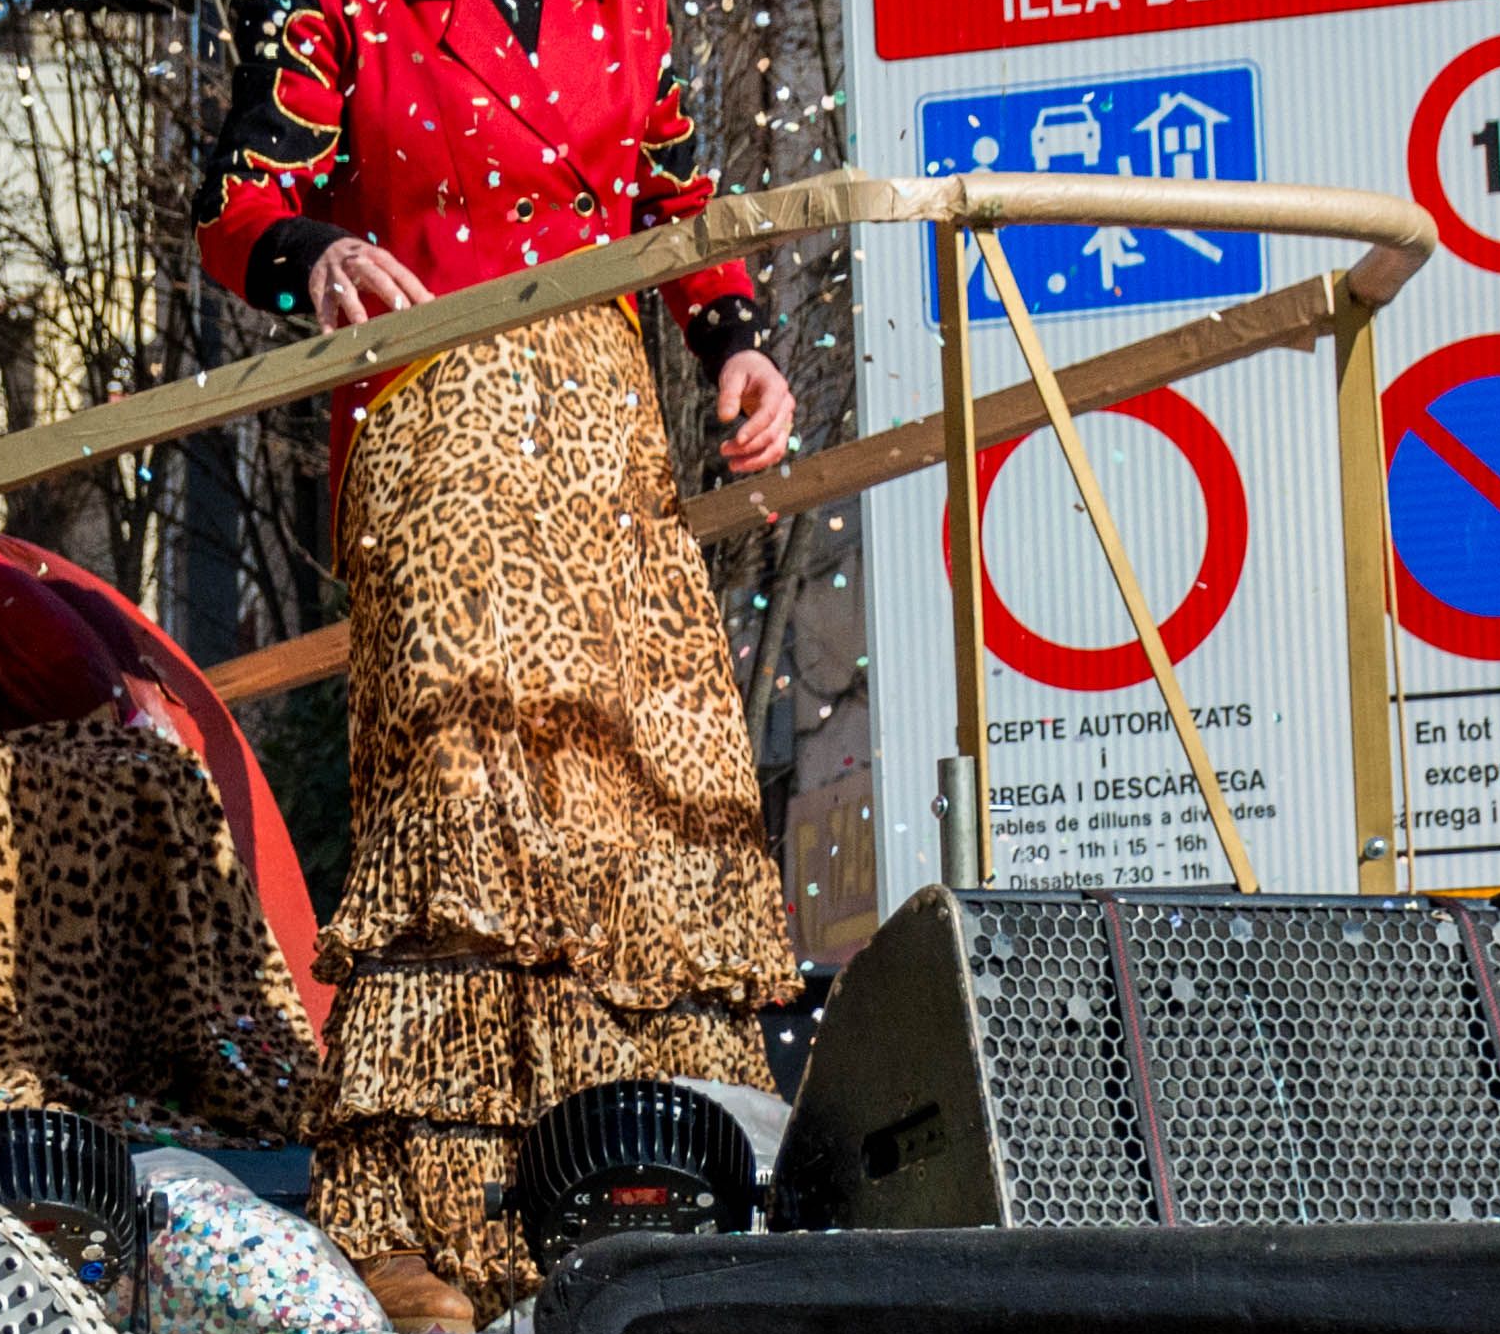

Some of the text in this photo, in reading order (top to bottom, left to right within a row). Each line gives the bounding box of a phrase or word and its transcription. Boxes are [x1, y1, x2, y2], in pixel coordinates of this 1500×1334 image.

[987, 704, 1252, 744] CEPTE AUTORIZATS
[1415, 721, 1446, 744] En
[1458, 717, 1491, 741] tot
[1100, 746, 1107, 769] i
[988, 768, 1266, 807] RREGA I DESCÀREGA
[1056, 811, 1078, 831] de
[1089, 809, 1151, 830] dilluns
[1161, 814, 1172, 825] a
[1180, 802, 1276, 824] divdres
[1395, 803, 1481, 831] àrrega
[1492, 801, 1498, 823] i
[1078, 843, 1105, 860] 11h
[1128, 838, 1147, 856] 15
[1175, 834, 1207, 853] 16h
[1009, 872, 1105, 891] Dissabtes
[1114, 865, 1154, 884] 7:30
[1181, 862, 1209, 881] 11h
